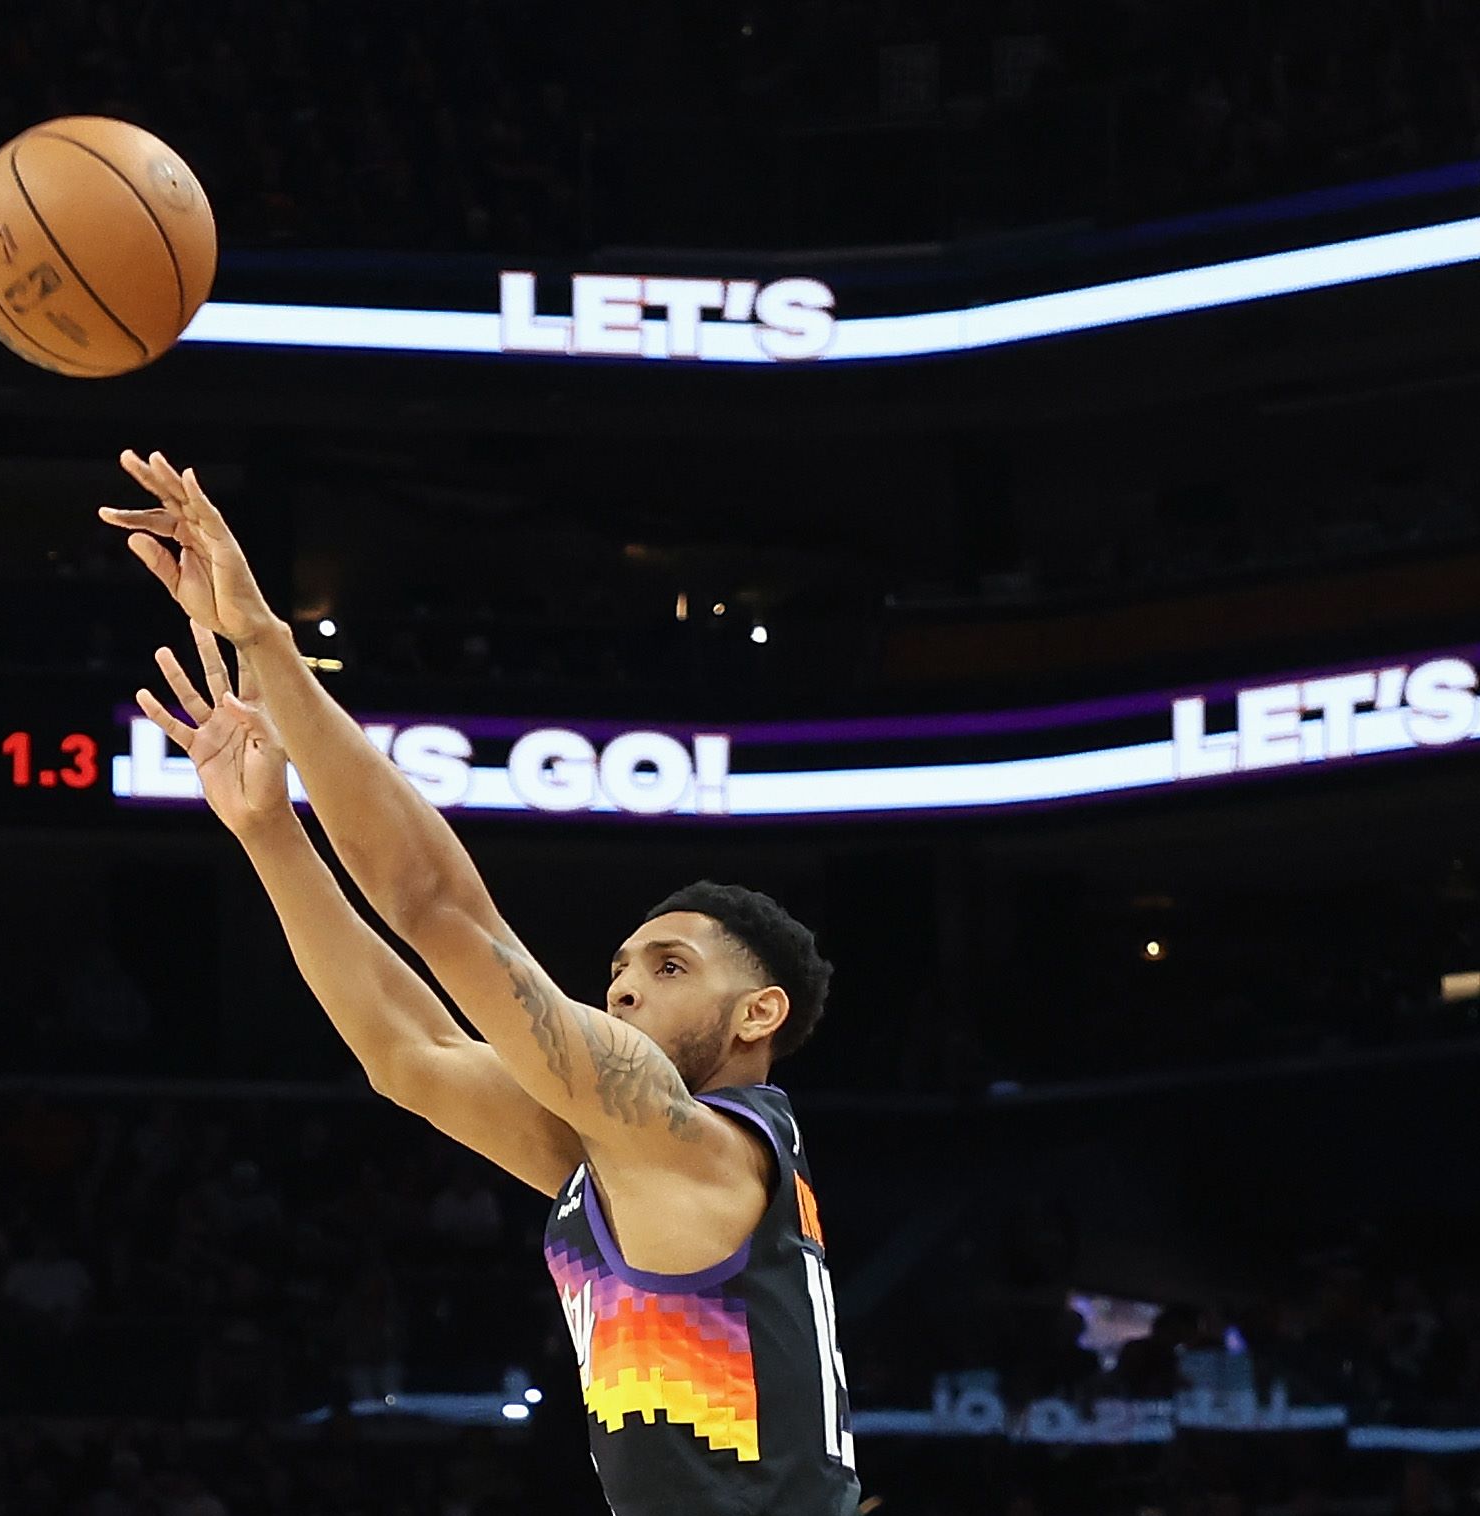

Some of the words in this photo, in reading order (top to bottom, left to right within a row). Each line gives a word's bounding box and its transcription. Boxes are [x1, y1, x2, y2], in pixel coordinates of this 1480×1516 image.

[499, 270, 837, 362] LET'S
[2, 731, 98, 789] 1.3
[1172, 657, 1479, 782] LET'S
[508, 728, 731, 814] GO!
